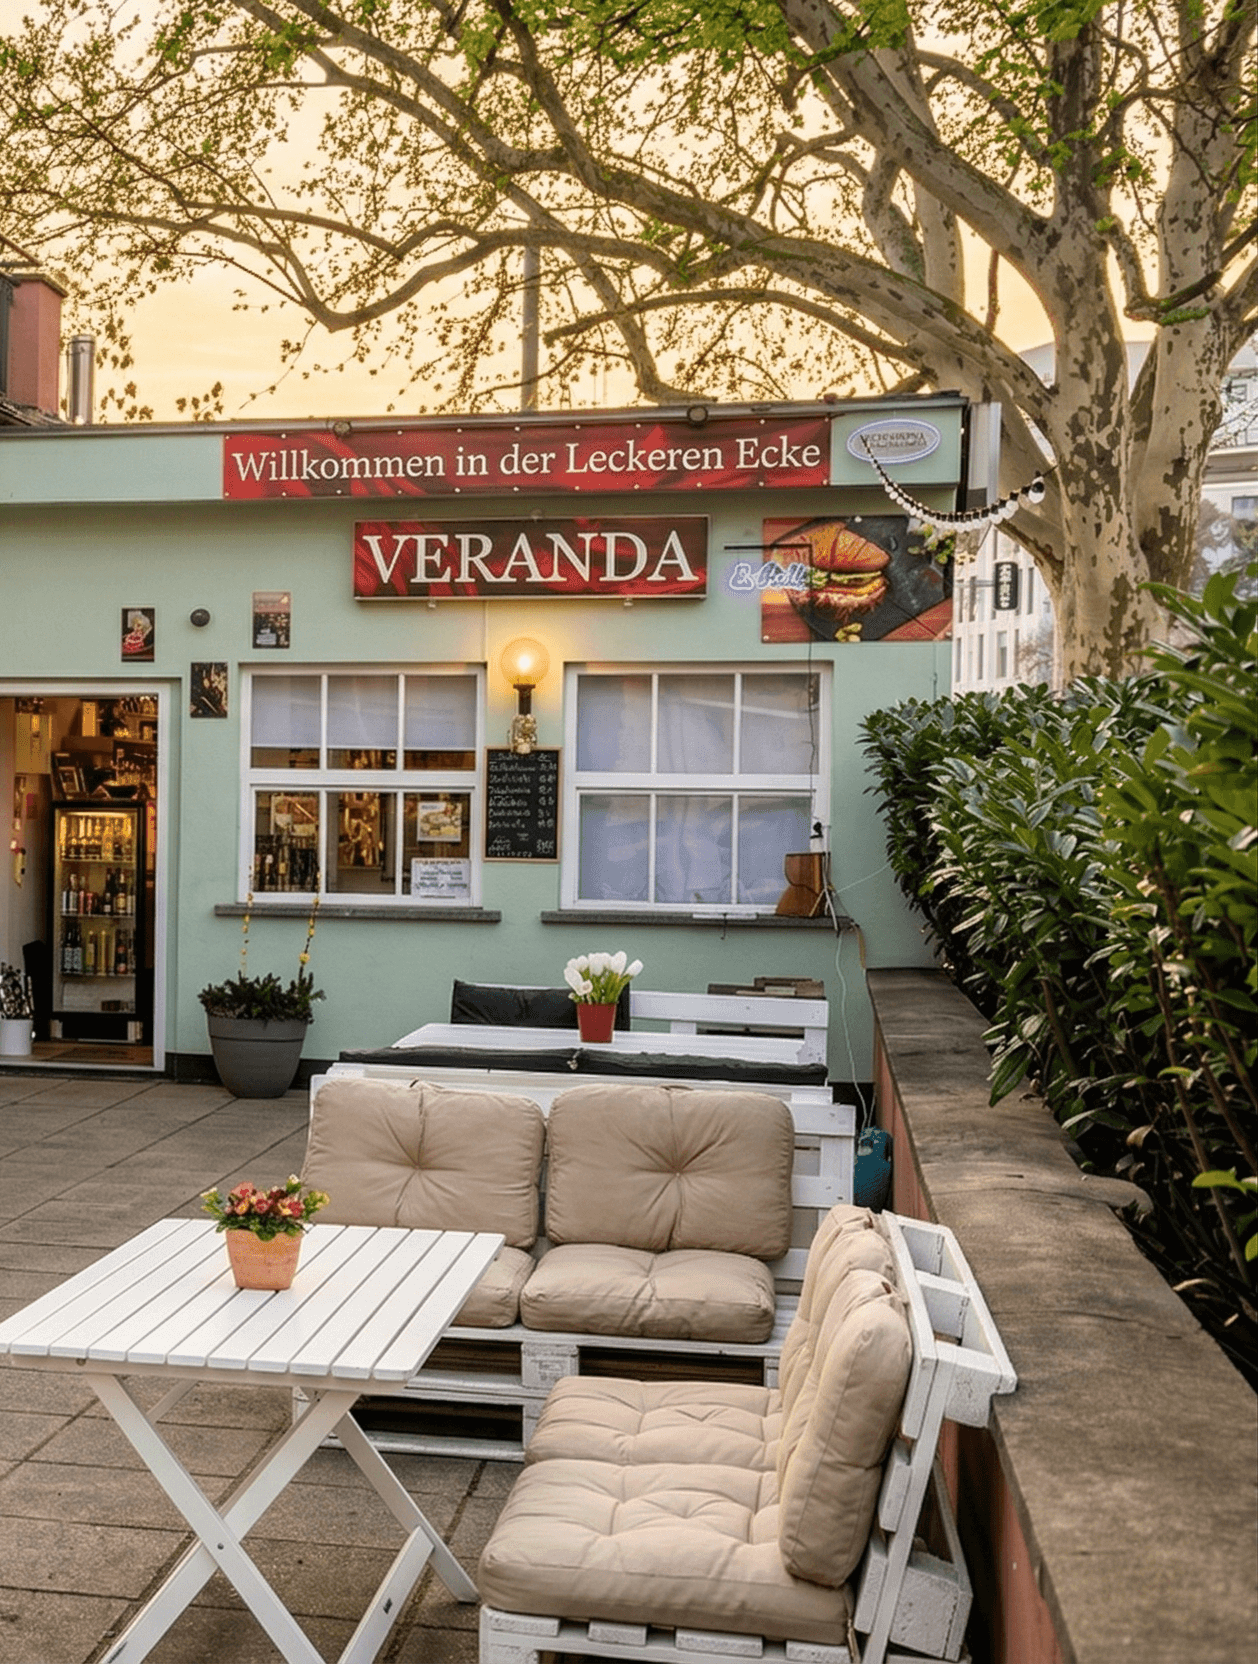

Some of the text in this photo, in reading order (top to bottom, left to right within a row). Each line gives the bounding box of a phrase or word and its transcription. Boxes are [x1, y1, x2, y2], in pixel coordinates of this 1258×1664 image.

[231, 449, 445, 482] Willkommen
[455, 446, 489, 477] in
[499, 443, 556, 476] der
[565, 439, 725, 474] Leckeren
[735, 435, 821, 470] Ecke
[362, 530, 699, 584] VERANDA
